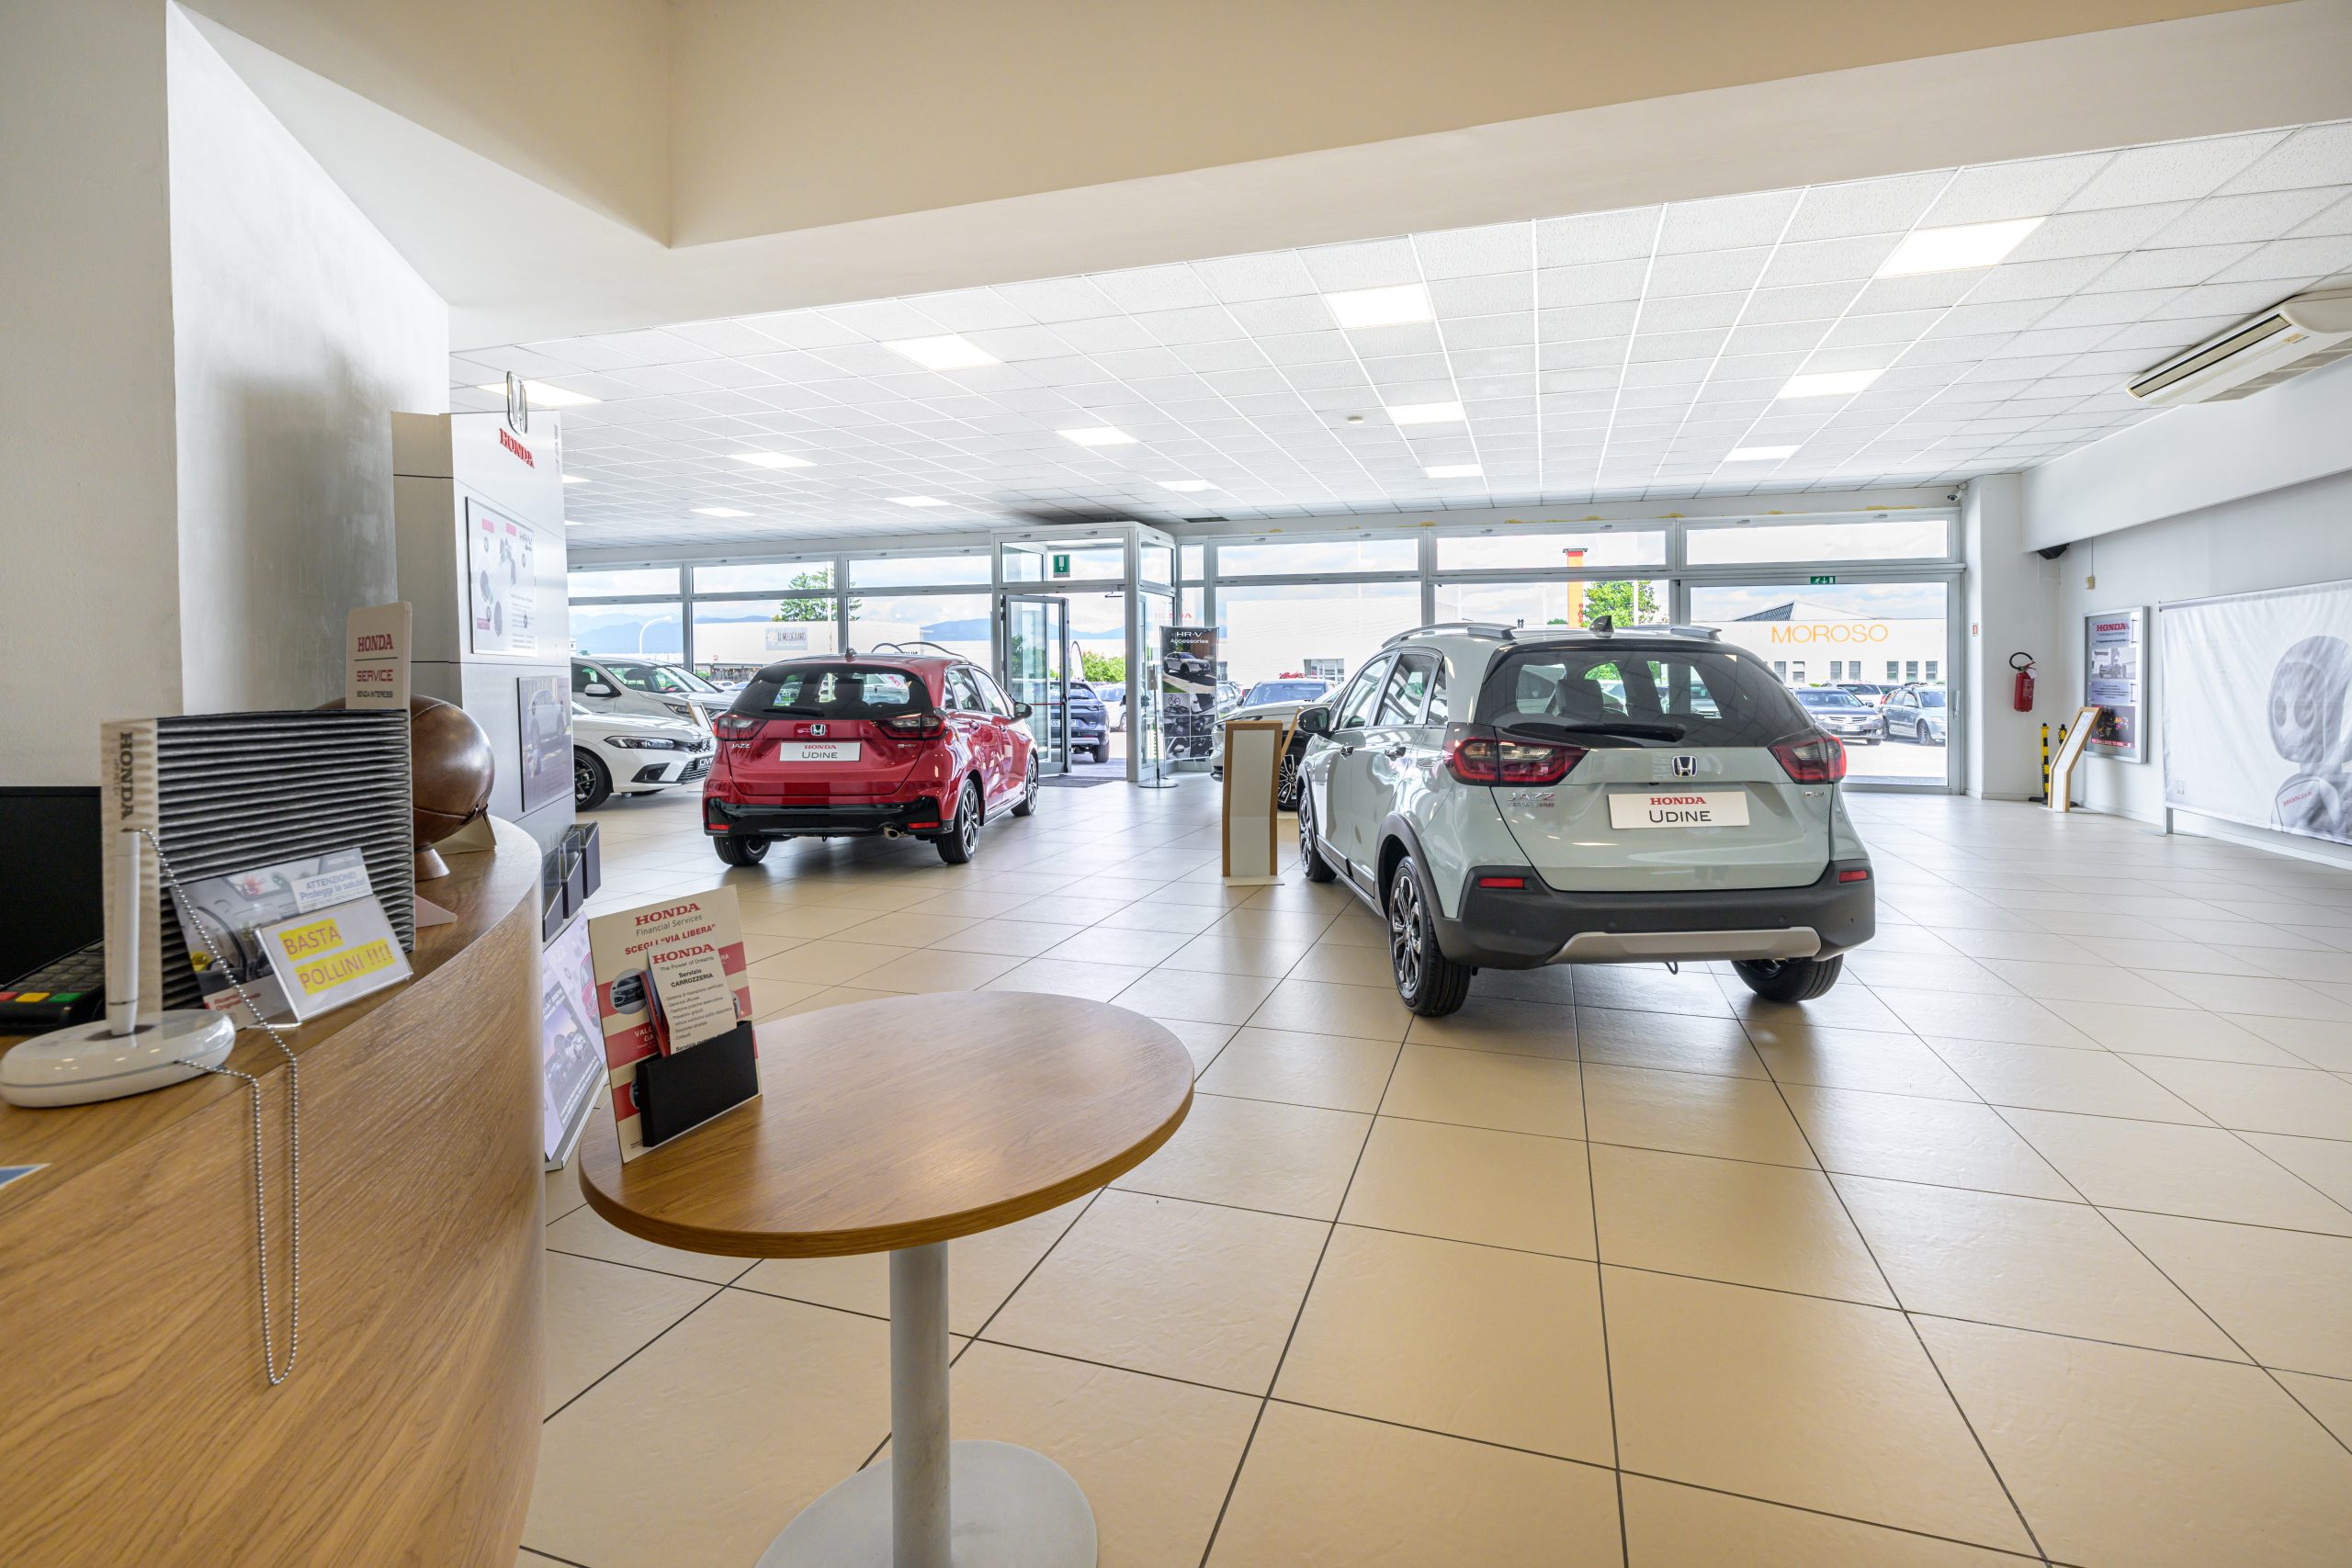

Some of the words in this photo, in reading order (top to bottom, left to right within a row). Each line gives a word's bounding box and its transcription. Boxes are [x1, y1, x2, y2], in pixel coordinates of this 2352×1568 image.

[500, 428, 535, 468] HONDA
[1771, 625, 1888, 644] MOROSO
[2097, 623, 2126, 631] HONDA
[357, 634, 393, 652] HONDA
[356, 669, 393, 682] SERVICE
[119, 731, 133, 820] HONDA
[1507, 793, 1555, 801] JAZZ
[1649, 796, 1707, 806] HONDA
[2282, 791, 2312, 807] HONDA
[1648, 809, 1712, 824] UDINE
[634, 902, 701, 927] HONDA
[636, 921, 671, 937] Financial
[673, 914, 703, 928] Services
[283, 925, 342, 956] BASTA
[651, 943, 716, 964] HONDA
[299, 954, 365, 990] POLLINI
[367, 943, 393, 965] !!!!
[671, 962, 687, 970] Power
[695, 955, 714, 965] Dreams
[671, 973, 714, 987] CARROZZERIA
[679, 968, 702, 978] Servizio
